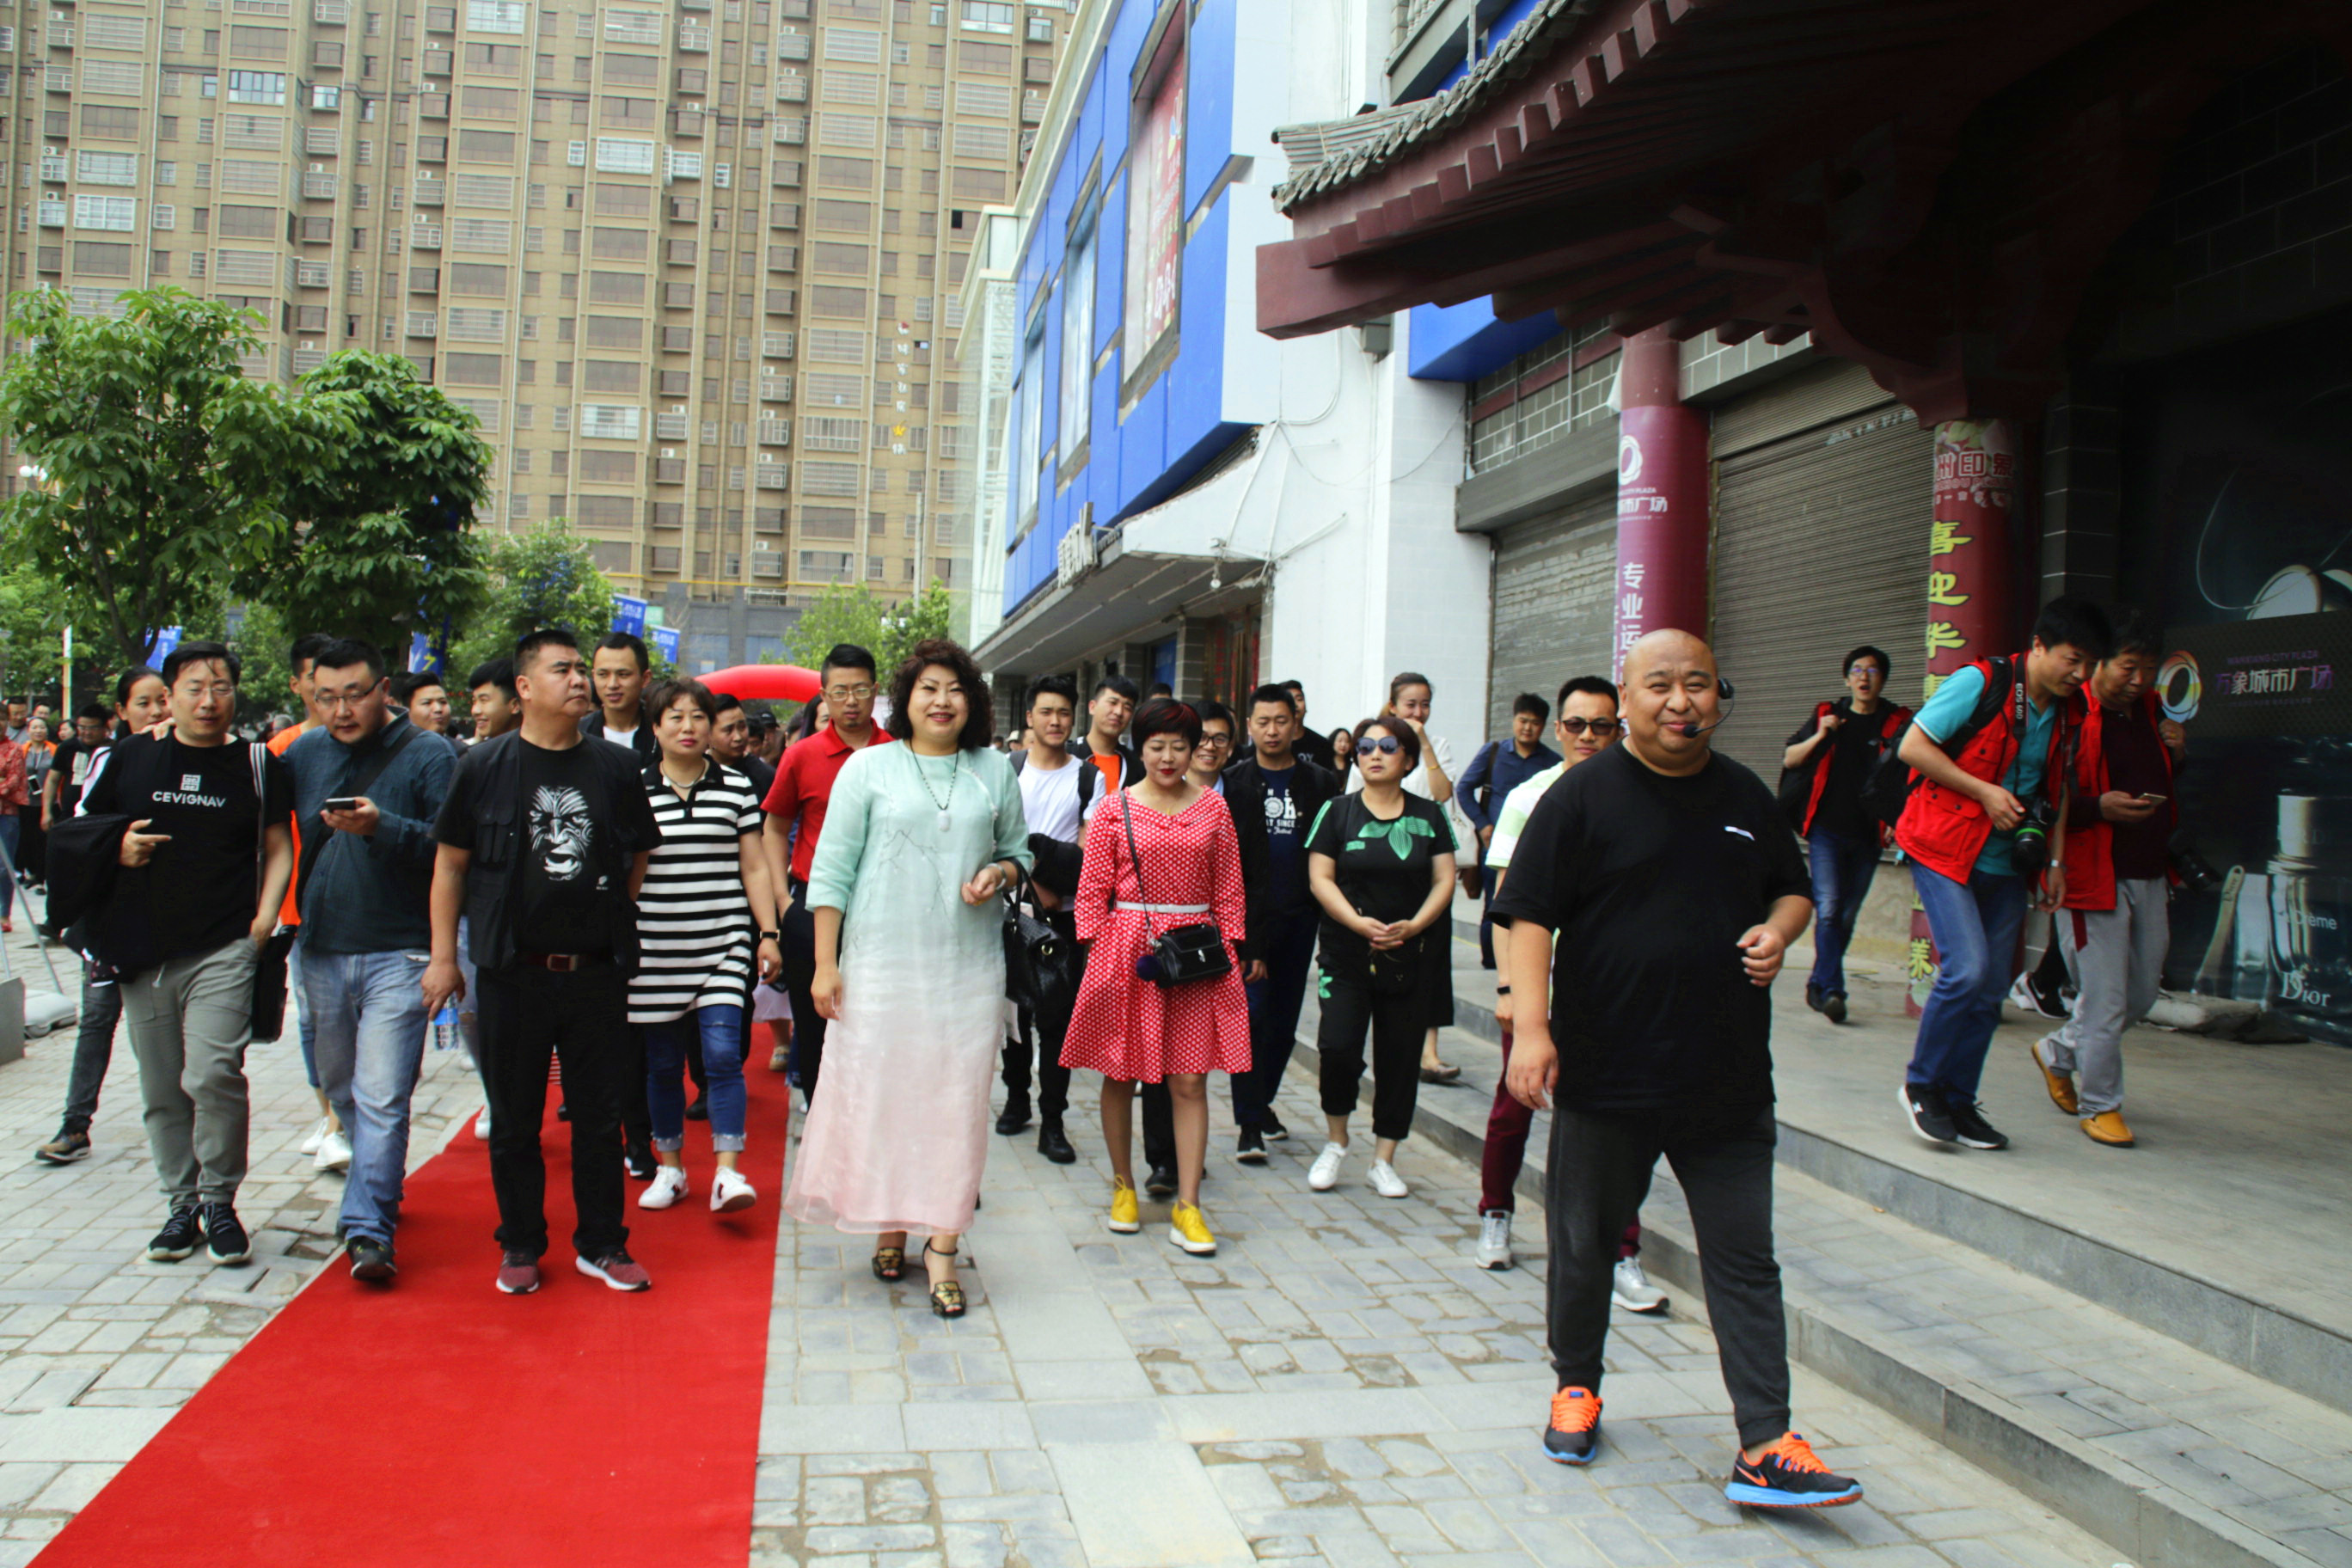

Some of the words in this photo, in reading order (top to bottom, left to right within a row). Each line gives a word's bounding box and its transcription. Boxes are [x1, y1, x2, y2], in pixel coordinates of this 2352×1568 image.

[2272, 652, 2290, 662] CITY
[2292, 649, 2319, 660] PLAZA
[2214, 665, 2334, 695] 万象城市广场
[1277, 819, 1295, 828] SINCE
[2279, 970, 2331, 1007] Dior
